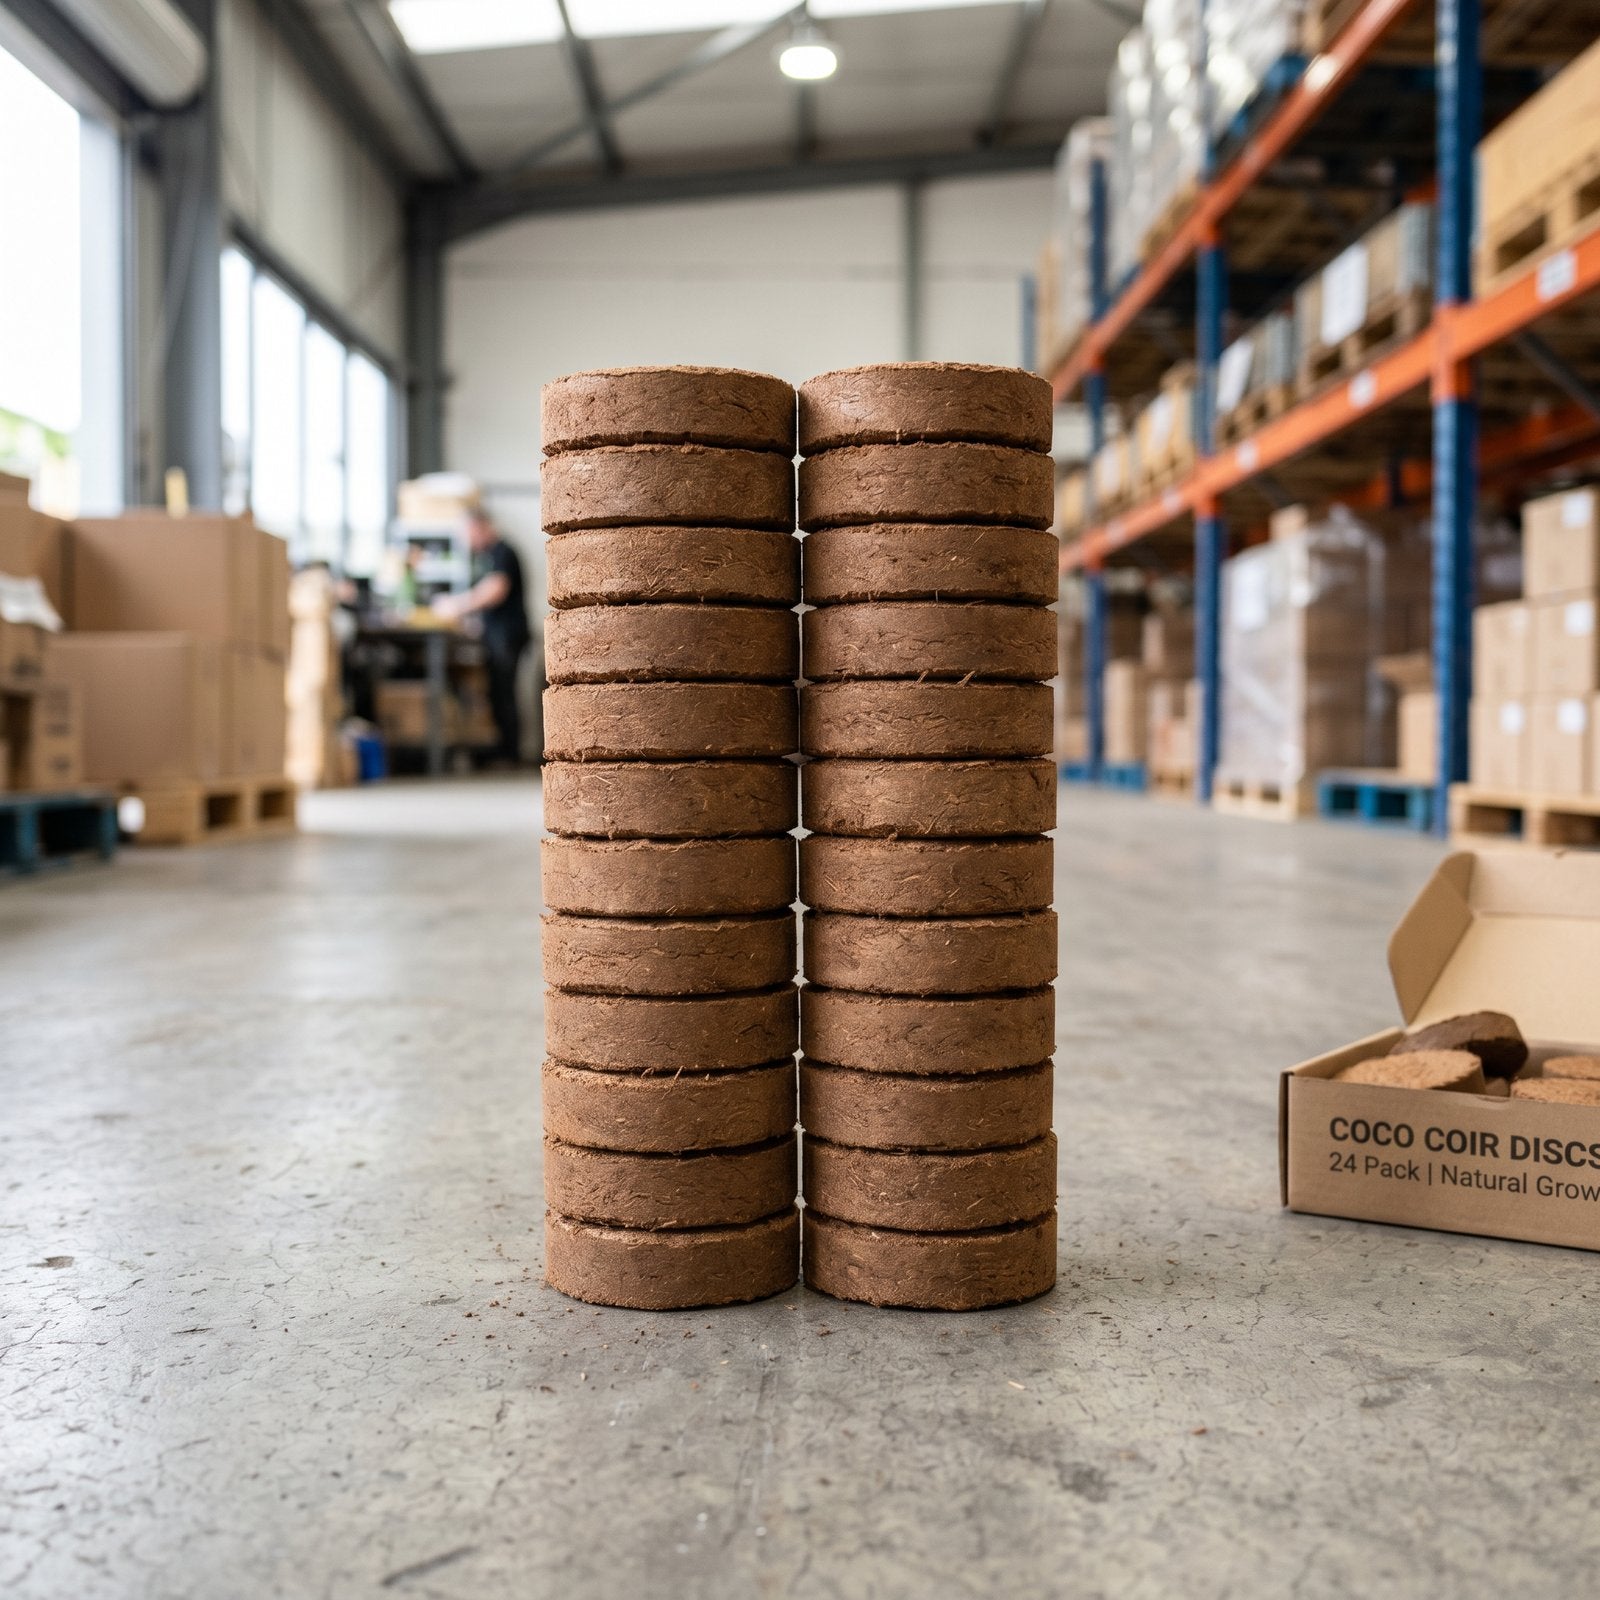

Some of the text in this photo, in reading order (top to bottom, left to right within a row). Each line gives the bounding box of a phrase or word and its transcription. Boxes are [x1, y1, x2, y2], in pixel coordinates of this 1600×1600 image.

[1329, 1117, 1600, 1169] COCO COIR DISCS
[1329, 1152, 1357, 1174] 24
[1365, 1155, 1420, 1181] Pack
[1441, 1164, 1527, 1194] Natural
[1536, 1175, 1600, 1202] Grow
